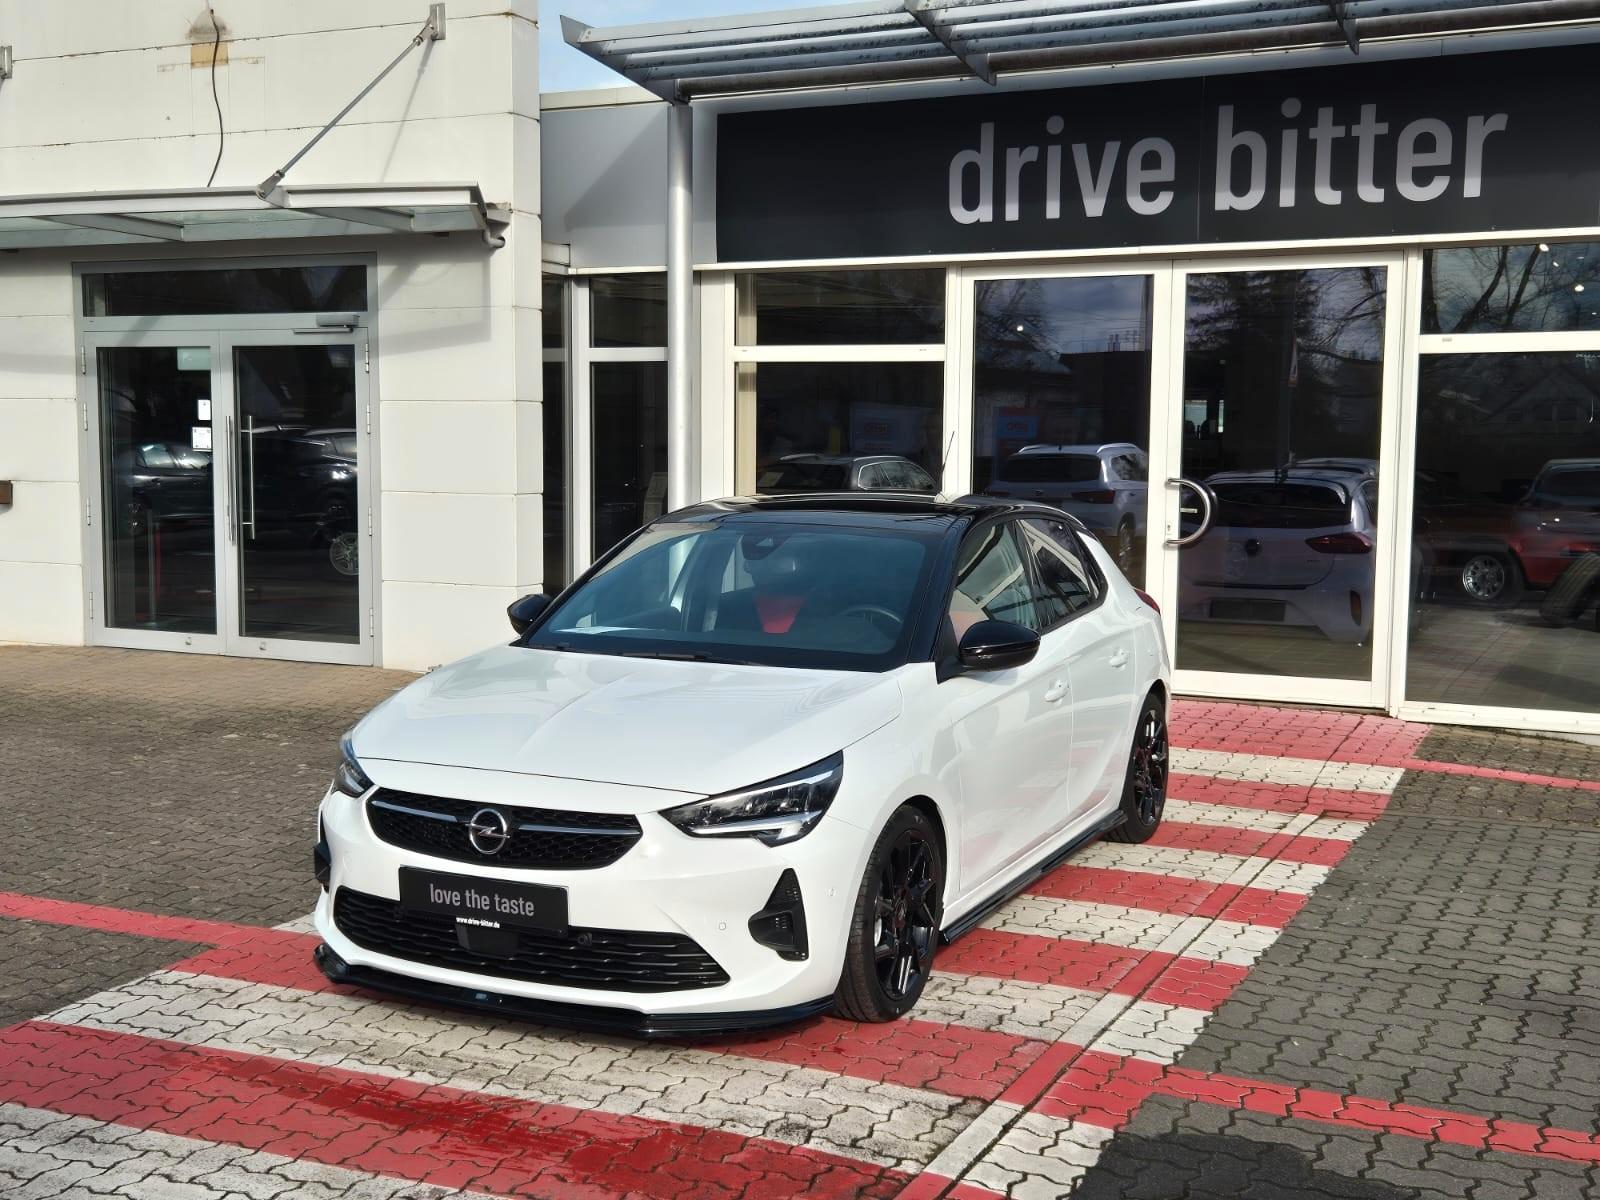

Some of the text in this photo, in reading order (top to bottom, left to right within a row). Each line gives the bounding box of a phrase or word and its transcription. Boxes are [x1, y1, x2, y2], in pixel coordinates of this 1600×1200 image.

[948, 97, 1508, 225] drive bitter
[430, 883, 535, 917] love the taste
[456, 916, 500, 929] www.drive-bitter.de
